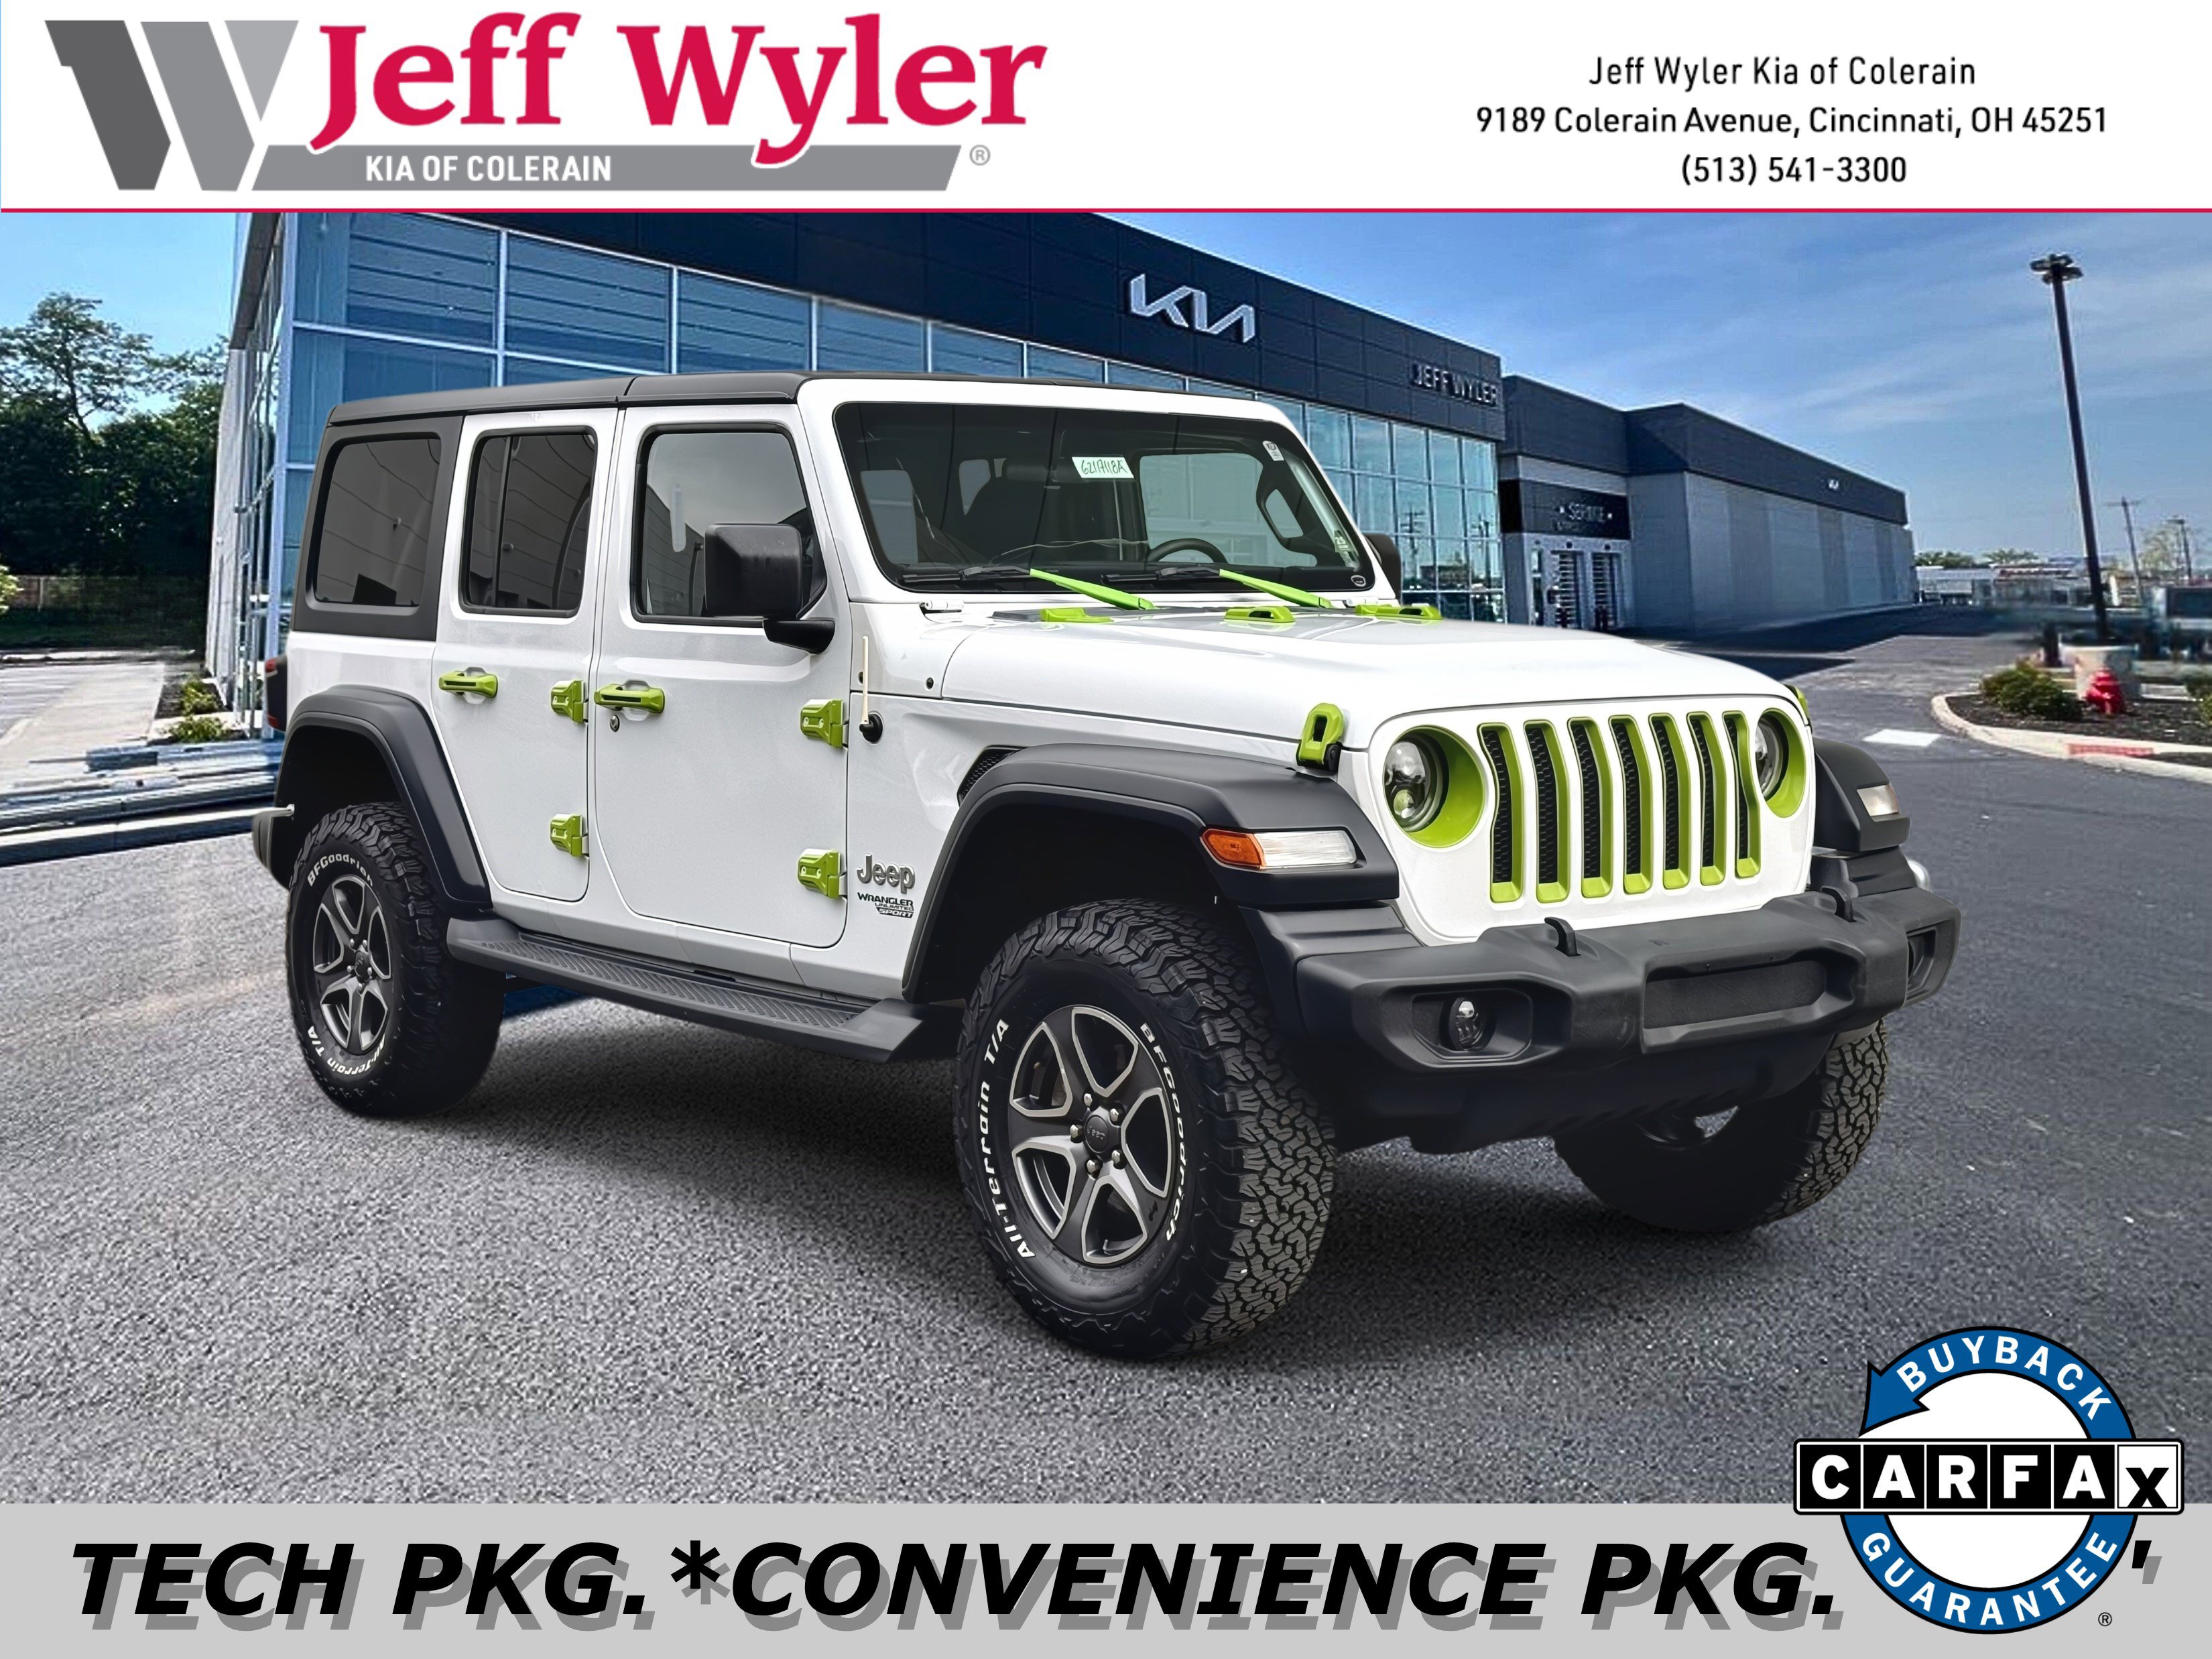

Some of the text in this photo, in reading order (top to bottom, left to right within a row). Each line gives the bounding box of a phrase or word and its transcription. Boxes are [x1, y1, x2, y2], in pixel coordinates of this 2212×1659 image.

[1130, 273, 1255, 343] KIA
[1413, 363, 1498, 406] JEFF WYLER
[307, 853, 373, 887] BFGoodrich
[857, 853, 916, 895] Jeep
[857, 892, 914, 908] WRANGLER
[874, 903, 914, 912] UNLIMITED
[878, 907, 914, 918] SPORT
[308, 1026, 325, 1057] T/A
[977, 1019, 1036, 1258] All-Terrain T/A
[1140, 1022, 1186, 1241] BFGoodrich
